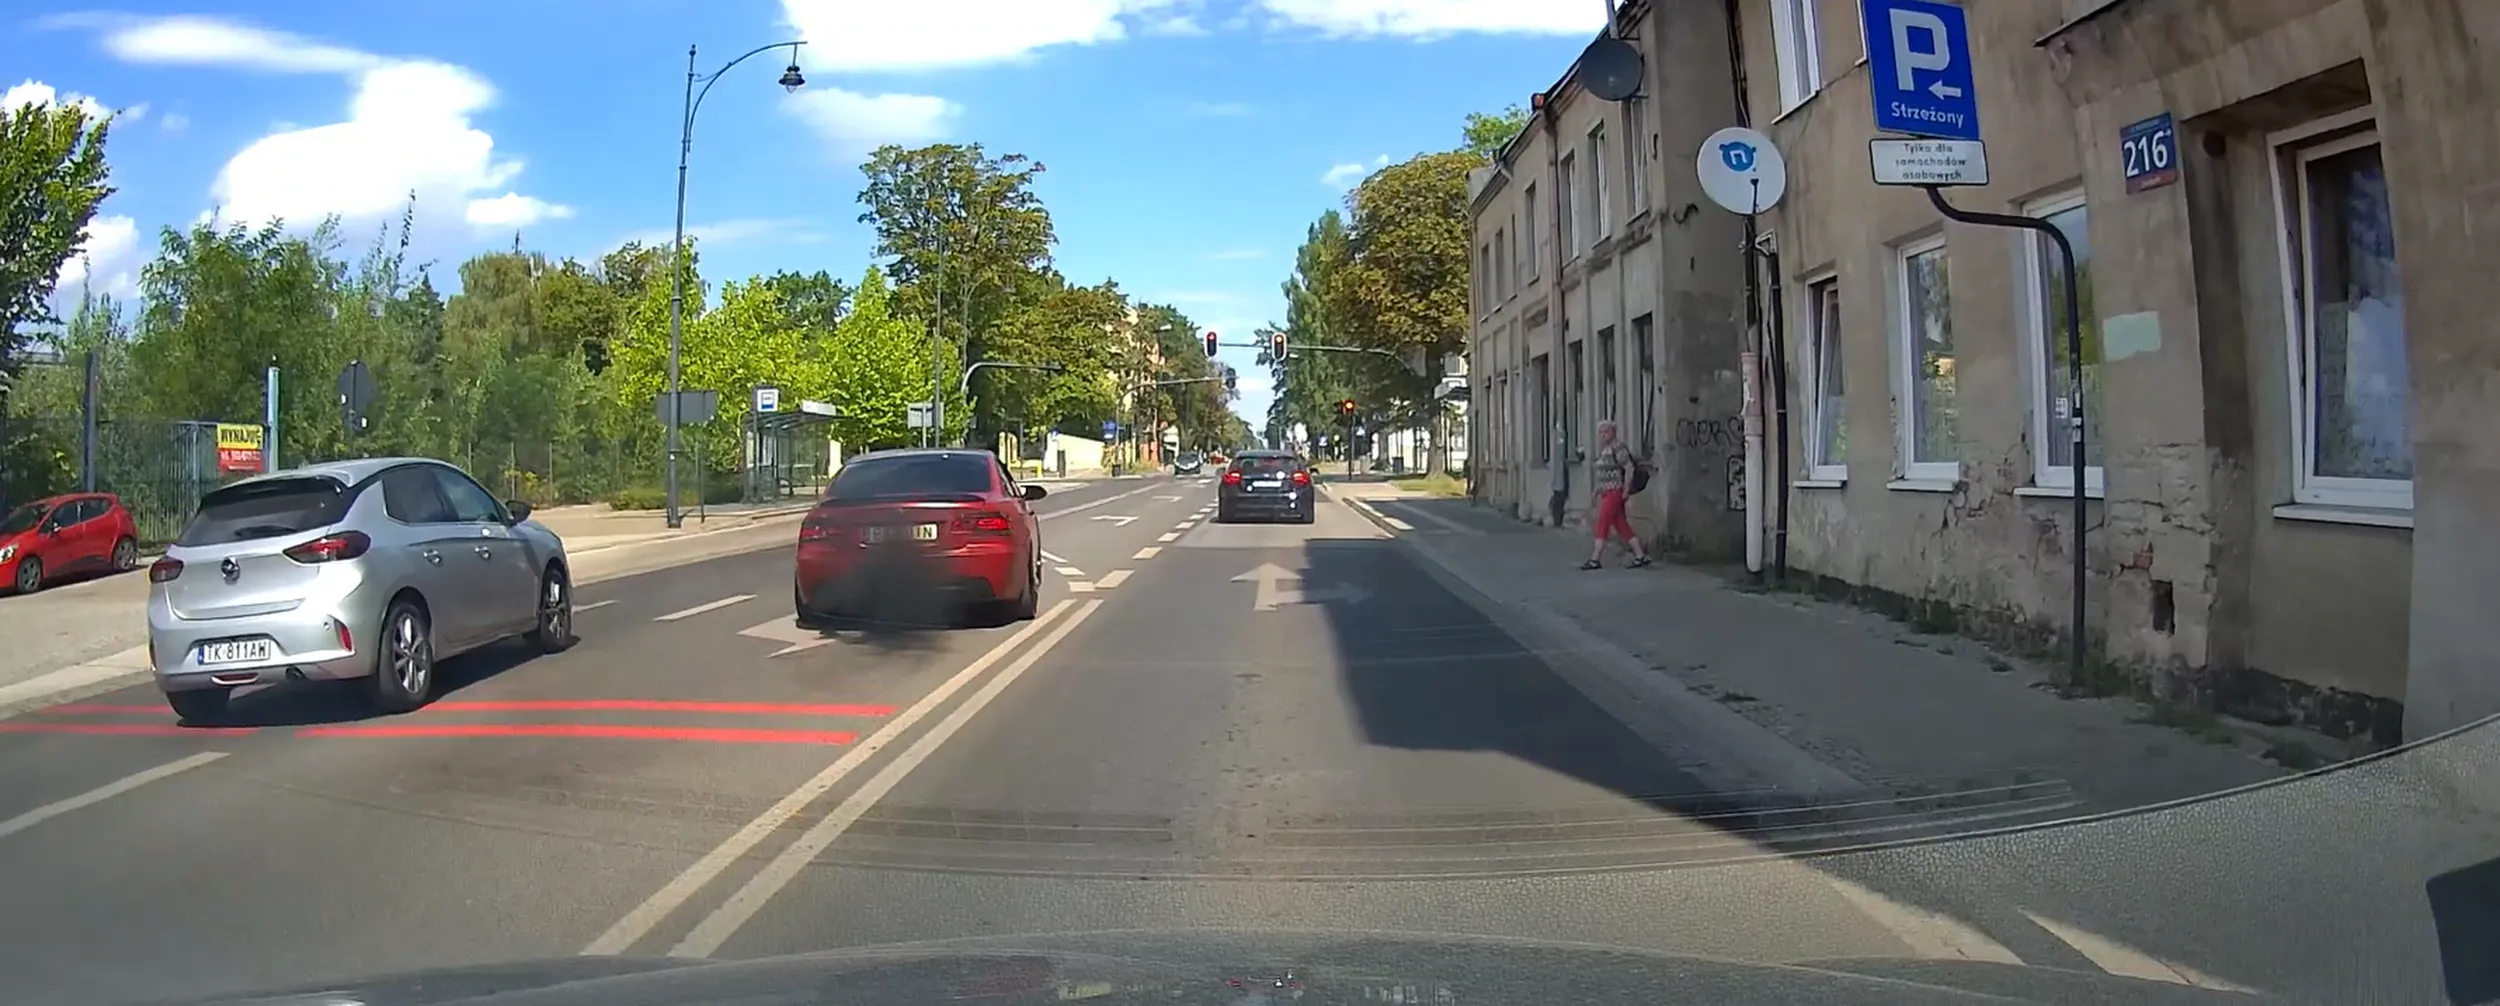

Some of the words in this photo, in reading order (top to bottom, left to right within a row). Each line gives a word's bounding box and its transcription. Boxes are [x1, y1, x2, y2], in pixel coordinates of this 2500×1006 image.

[1889, 8, 1950, 91] P
[1891, 102, 1964, 129] Strzeżony
[1904, 143, 1931, 155] Tylko
[1935, 143, 1953, 153] dla
[2124, 130, 2168, 177] 216
[1895, 156, 1967, 168] samochodów
[1902, 171, 1962, 182] osobowych
[207, 644, 222, 661] TK
